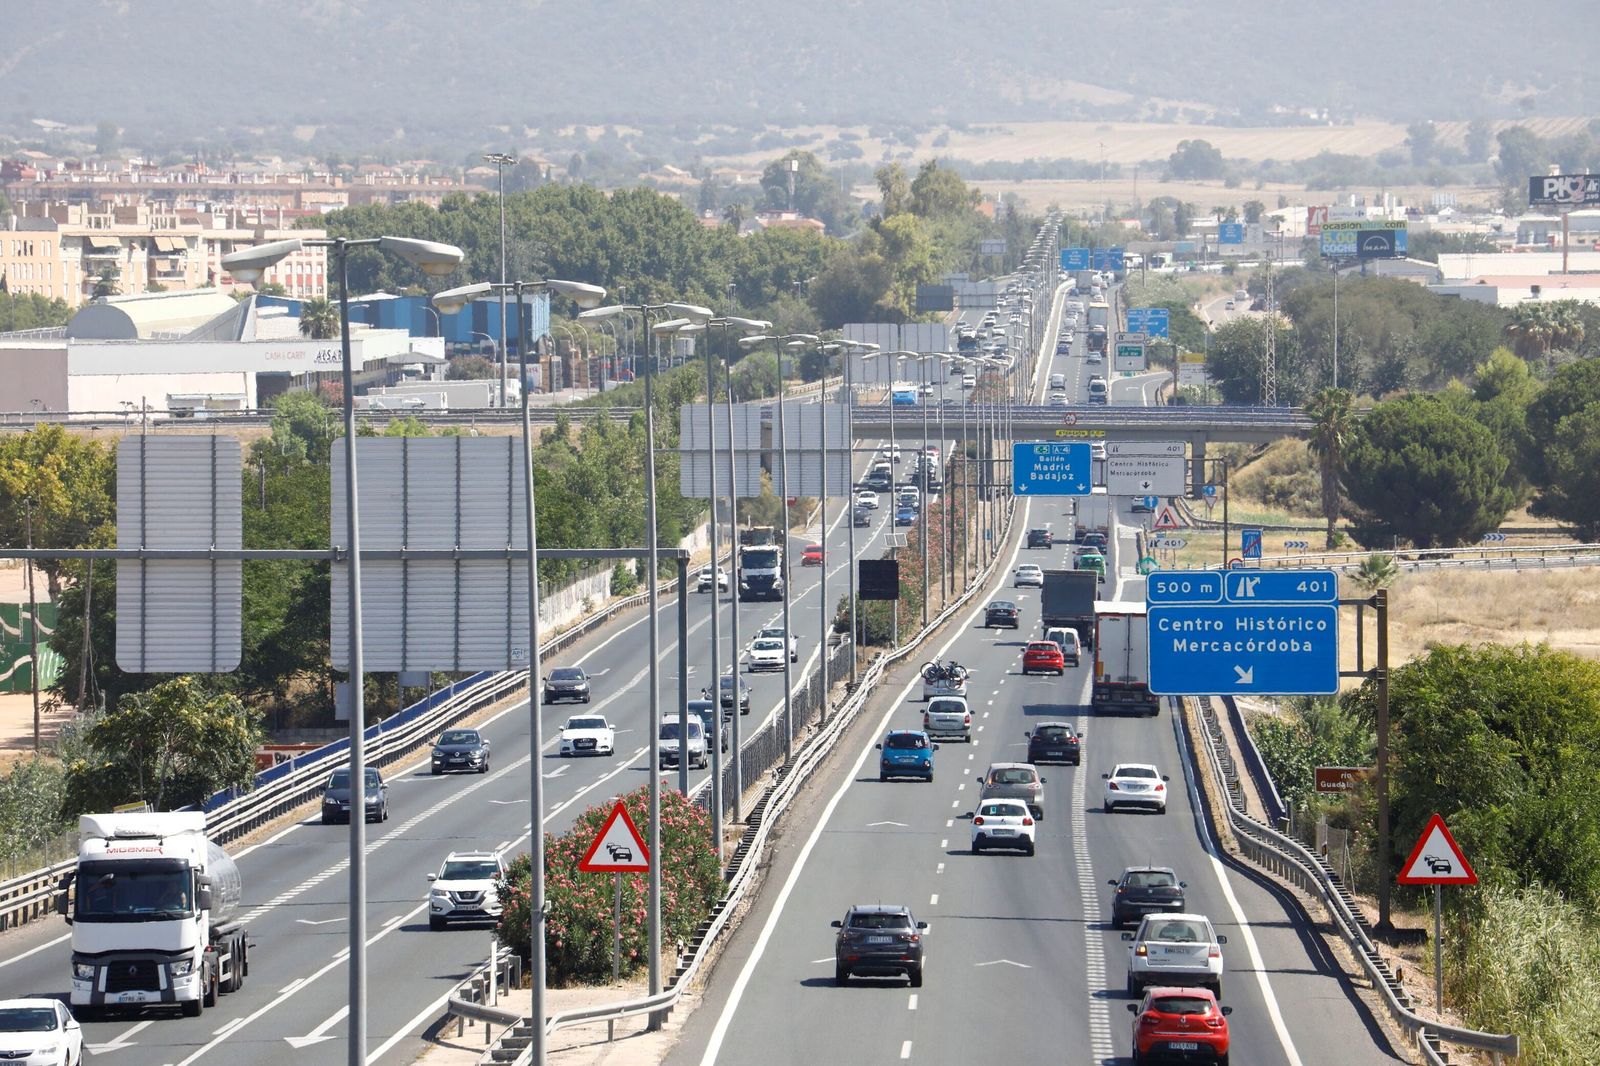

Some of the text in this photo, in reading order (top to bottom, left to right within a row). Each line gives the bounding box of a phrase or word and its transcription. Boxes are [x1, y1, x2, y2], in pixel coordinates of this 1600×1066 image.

[1035, 445, 1069, 454] E-5 A-4
[1034, 463, 1071, 471] Madrid
[1030, 472, 1074, 482] Badajoz
[1157, 581, 1213, 593] 500 m
[1296, 581, 1327, 593] 401
[1158, 616, 1327, 632] Centro Histórico
[1173, 638, 1312, 652] Mercacórdoba
